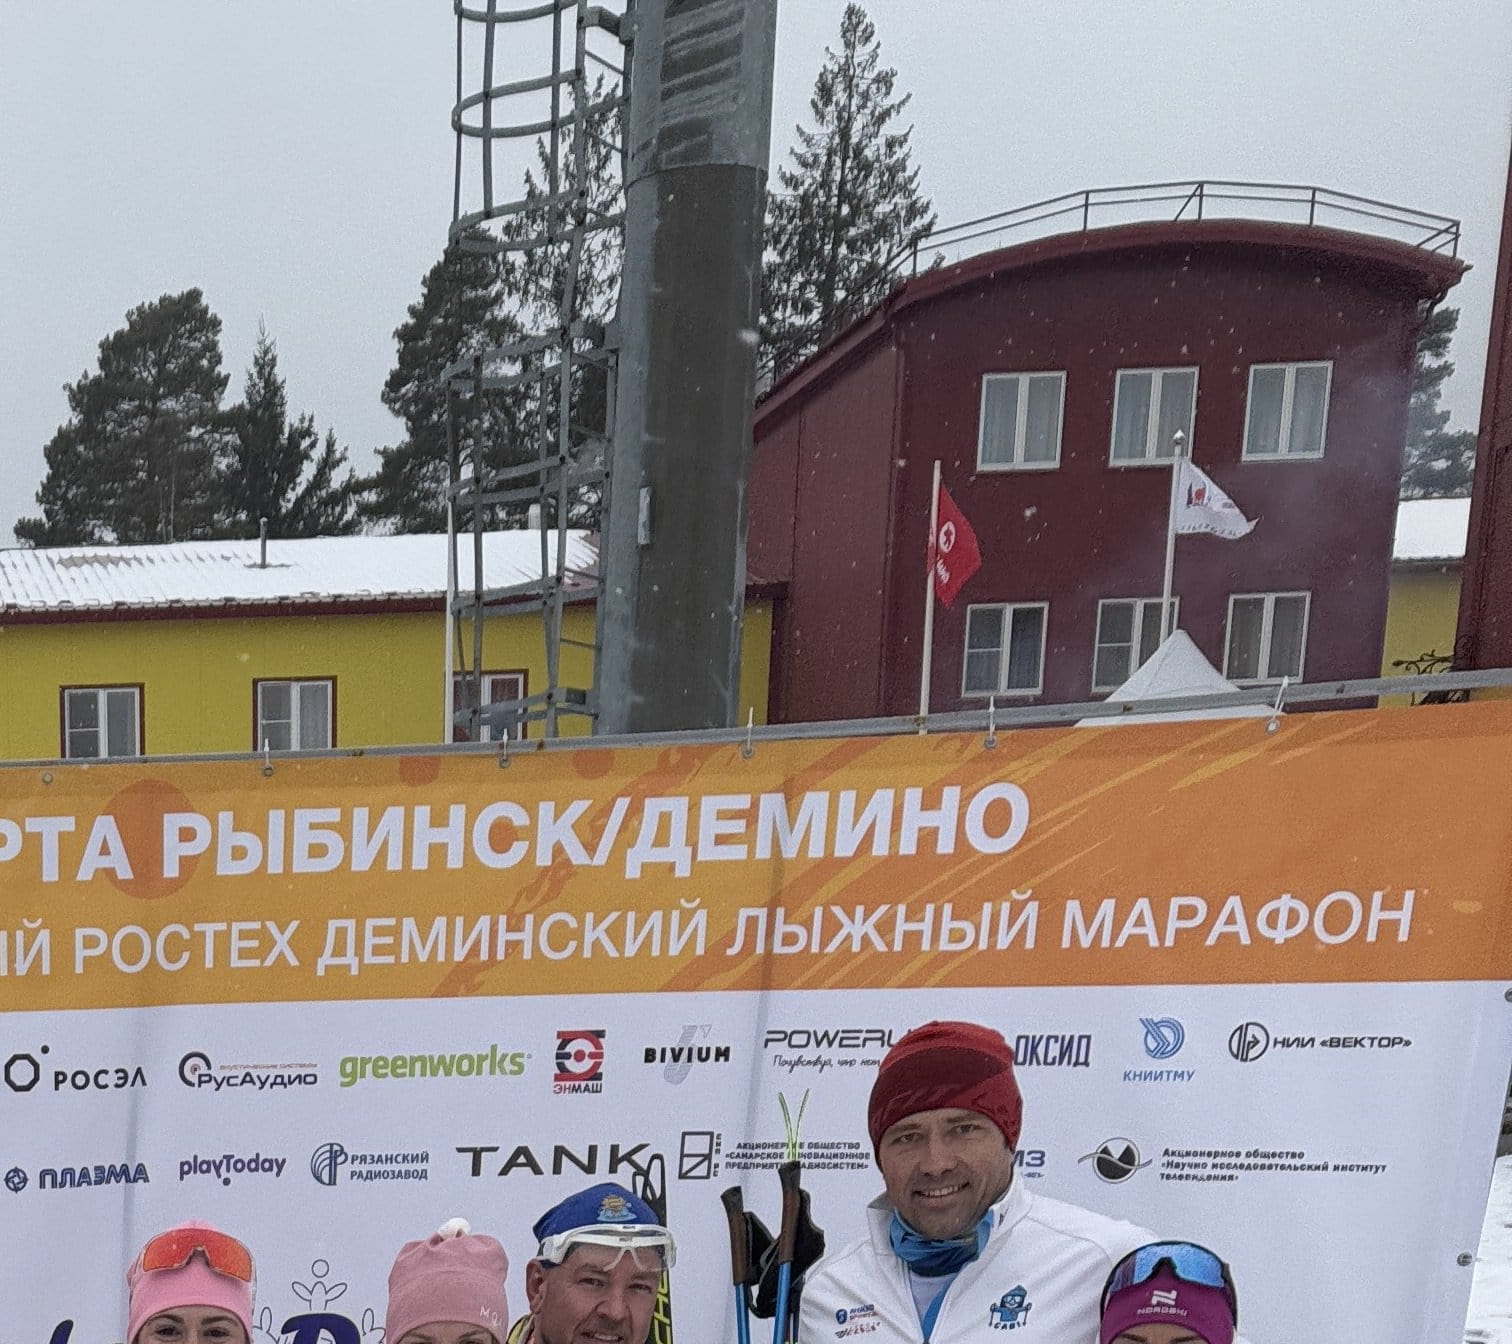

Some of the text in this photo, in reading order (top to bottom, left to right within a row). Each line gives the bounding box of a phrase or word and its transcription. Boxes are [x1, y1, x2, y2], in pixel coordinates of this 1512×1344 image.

[162, 782, 1029, 880] РЫБИНСК/ДЕМИНО
[75, 920, 301, 974] РОСТЕХ
[317, 899, 708, 976] ДЕМИНСКИЙ
[725, 889, 1036, 957] ЛЫЖНЫЙ
[1061, 888, 1417, 949] МАРАФОН
[1273, 1036, 1413, 1049] НИИ «ВЕКТОР»
[644, 1046, 730, 1064] BIVIUM
[340, 1044, 526, 1088] greenworks
[54, 1067, 148, 1091] РОСЭЛ
[197, 1071, 318, 1091] РусАудио
[1123, 1069, 1196, 1083] КНИИТМУ
[553, 1082, 603, 1095] ЭНМАШ
[736, 1142, 804, 1151] АКЦИОНЕРЕ
[1162, 1148, 1305, 1161] Акционерное общество
[350, 1150, 430, 1166] РЯЗАНСКИЙ
[455, 1142, 651, 1177] TANK
[800, 1161, 870, 1170] АДИОСИСТЕМ»
[39, 1163, 150, 1189] ПЛАЗМА
[179, 1154, 287, 1183] playToday
[350, 1168, 429, 1181] РАДИОЗАВОД
[1211, 1161, 1329, 1173] исследовательский
[1333, 1163, 1388, 1175] институт
